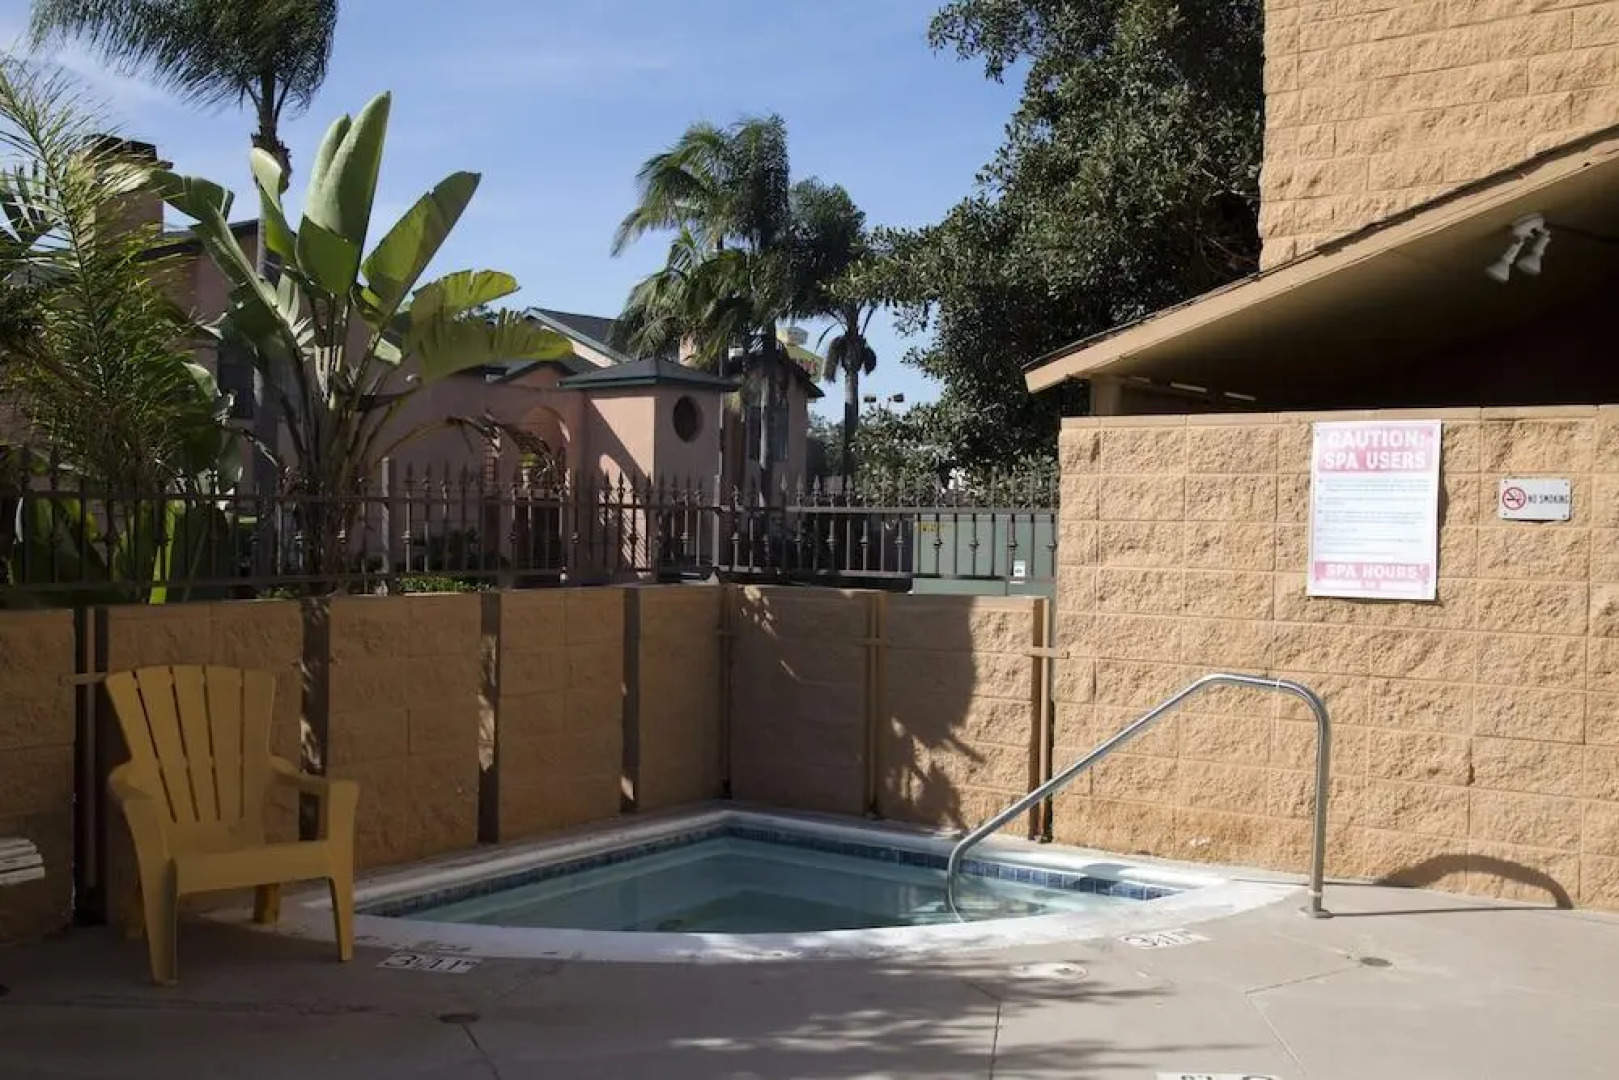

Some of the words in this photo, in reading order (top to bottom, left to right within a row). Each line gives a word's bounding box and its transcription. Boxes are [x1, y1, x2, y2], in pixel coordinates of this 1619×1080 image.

[1324, 451, 1359, 469] SPA
[1365, 451, 1426, 469] USERS
[1527, 493, 1537, 504] NO
[1539, 493, 1569, 504] SMOKING
[1324, 564, 1357, 579] SPA
